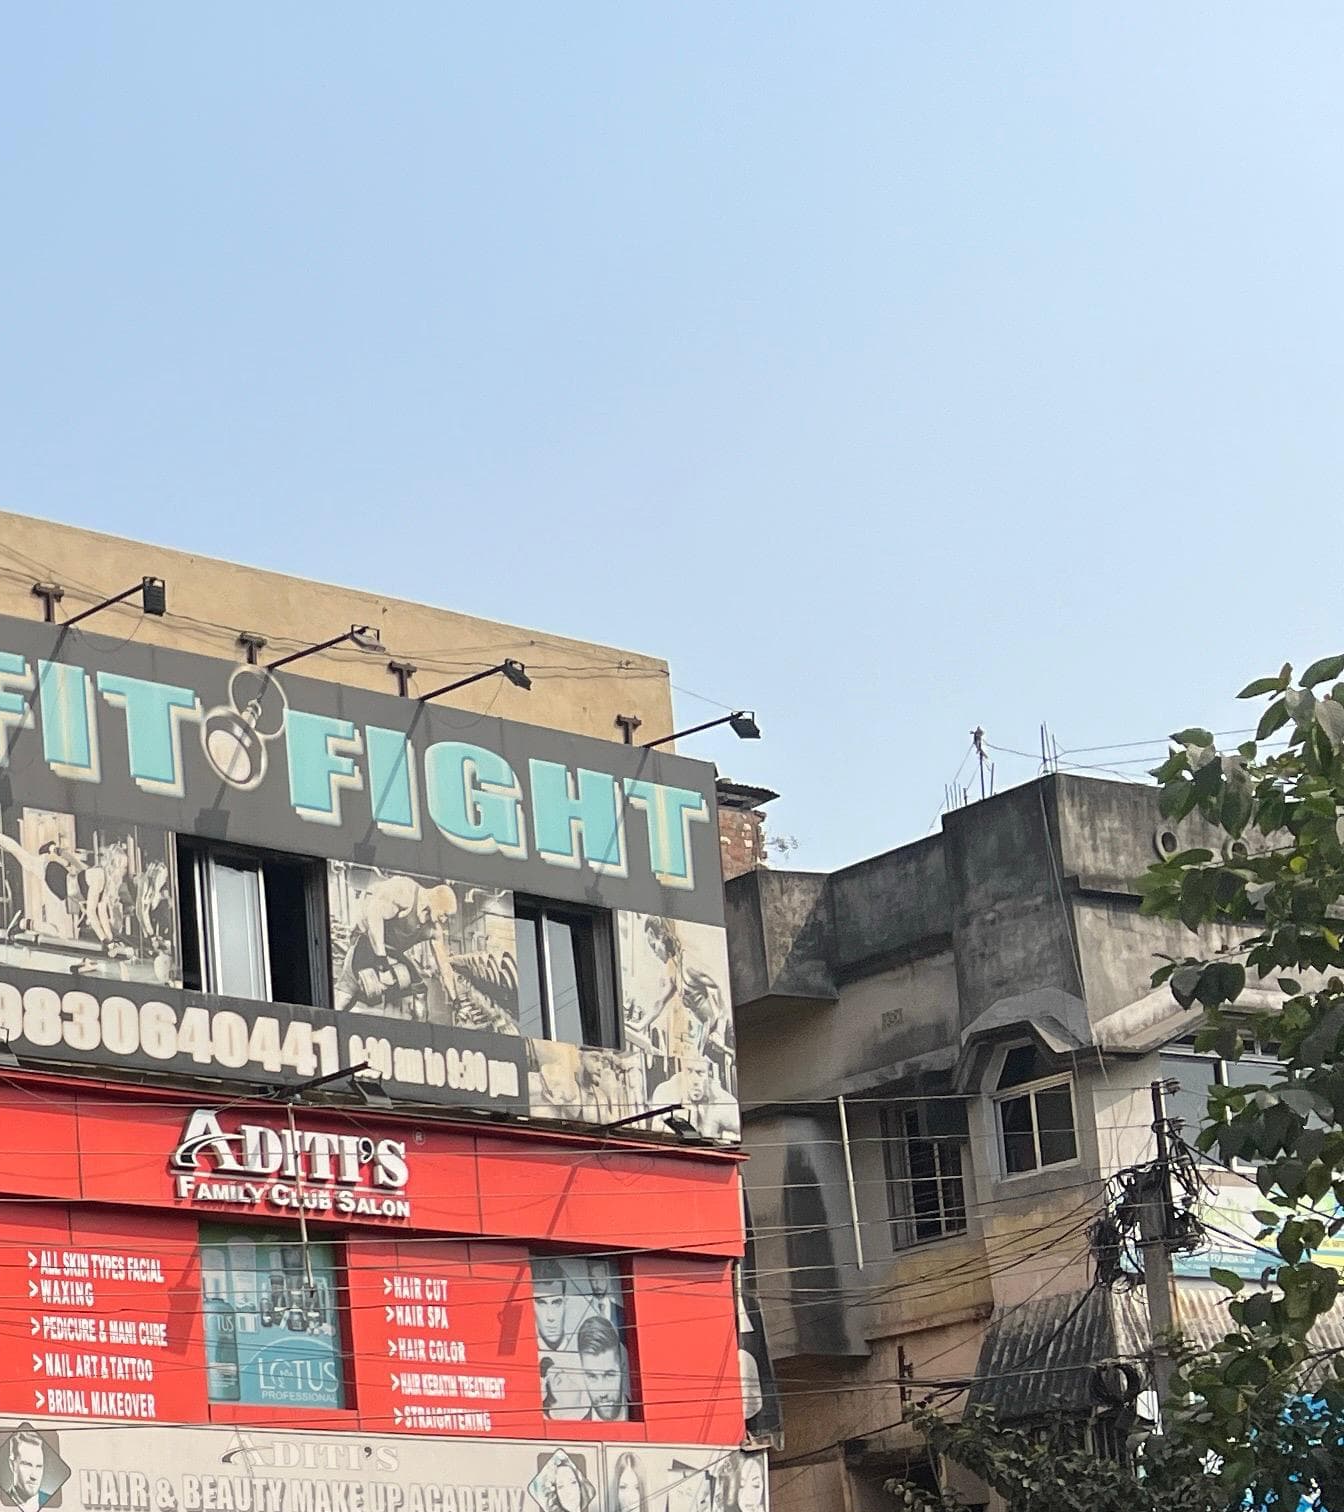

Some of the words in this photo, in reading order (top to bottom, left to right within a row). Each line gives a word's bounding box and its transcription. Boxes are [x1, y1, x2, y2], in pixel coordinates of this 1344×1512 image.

[284, 709, 708, 891] FIGHT
[171, 1108, 410, 1188] ADITI'S
[177, 1175, 265, 1204] FAMILY
[271, 1183, 333, 1210] CLUB
[338, 1190, 410, 1218] SALON
[40, 1250, 61, 1275] ALL
[63, 1251, 89, 1278] SKIN
[91, 1254, 126, 1280] TYPES
[127, 1257, 165, 1283] FACIAL
[40, 1279, 95, 1307] WAXING
[393, 1275, 422, 1300] HAIR
[425, 1279, 448, 1302] CUT
[43, 1315, 97, 1342] PEDICURE
[139, 1321, 168, 1347] CURE
[396, 1305, 424, 1327] HAIR
[427, 1306, 449, 1329] SPA
[398, 1338, 426, 1361] HAIR
[429, 1340, 466, 1363] COLOR
[45, 1352, 73, 1377] NAIL
[75, 1354, 98, 1378] ART
[109, 1356, 154, 1382] TATTOO
[258, 1358, 339, 1393] LOTUS
[47, 1388, 88, 1415] BRIDAL
[91, 1391, 156, 1418] MAKEOVER
[262, 1390, 337, 1401] PROFESSIONAL
[79, 1469, 150, 1512] HAIR
[155, 1477, 179, 1512] &
